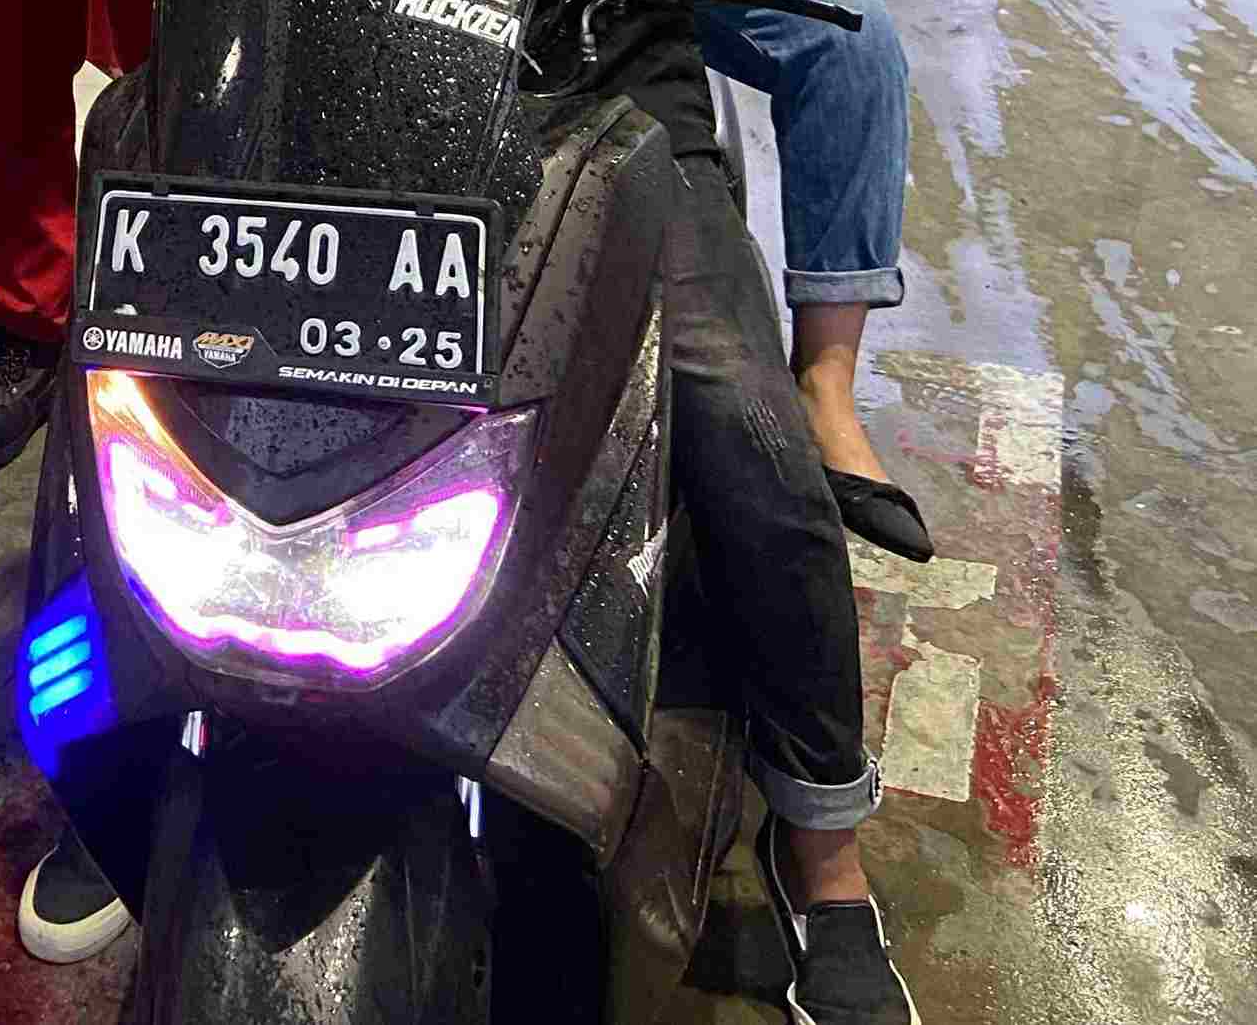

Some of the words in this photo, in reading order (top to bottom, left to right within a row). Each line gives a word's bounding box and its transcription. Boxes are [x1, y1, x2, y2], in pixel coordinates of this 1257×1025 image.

[112, 209, 150, 272] K
[199, 215, 339, 285] 3540
[389, 229, 470, 298] AA
[106, 330, 182, 359] YAMAHA
[202, 348, 237, 362] YAMAHA
[279, 366, 374, 386] SEMAKIN
[377, 374, 400, 388] DI
[401, 377, 477, 394] DEPAN
